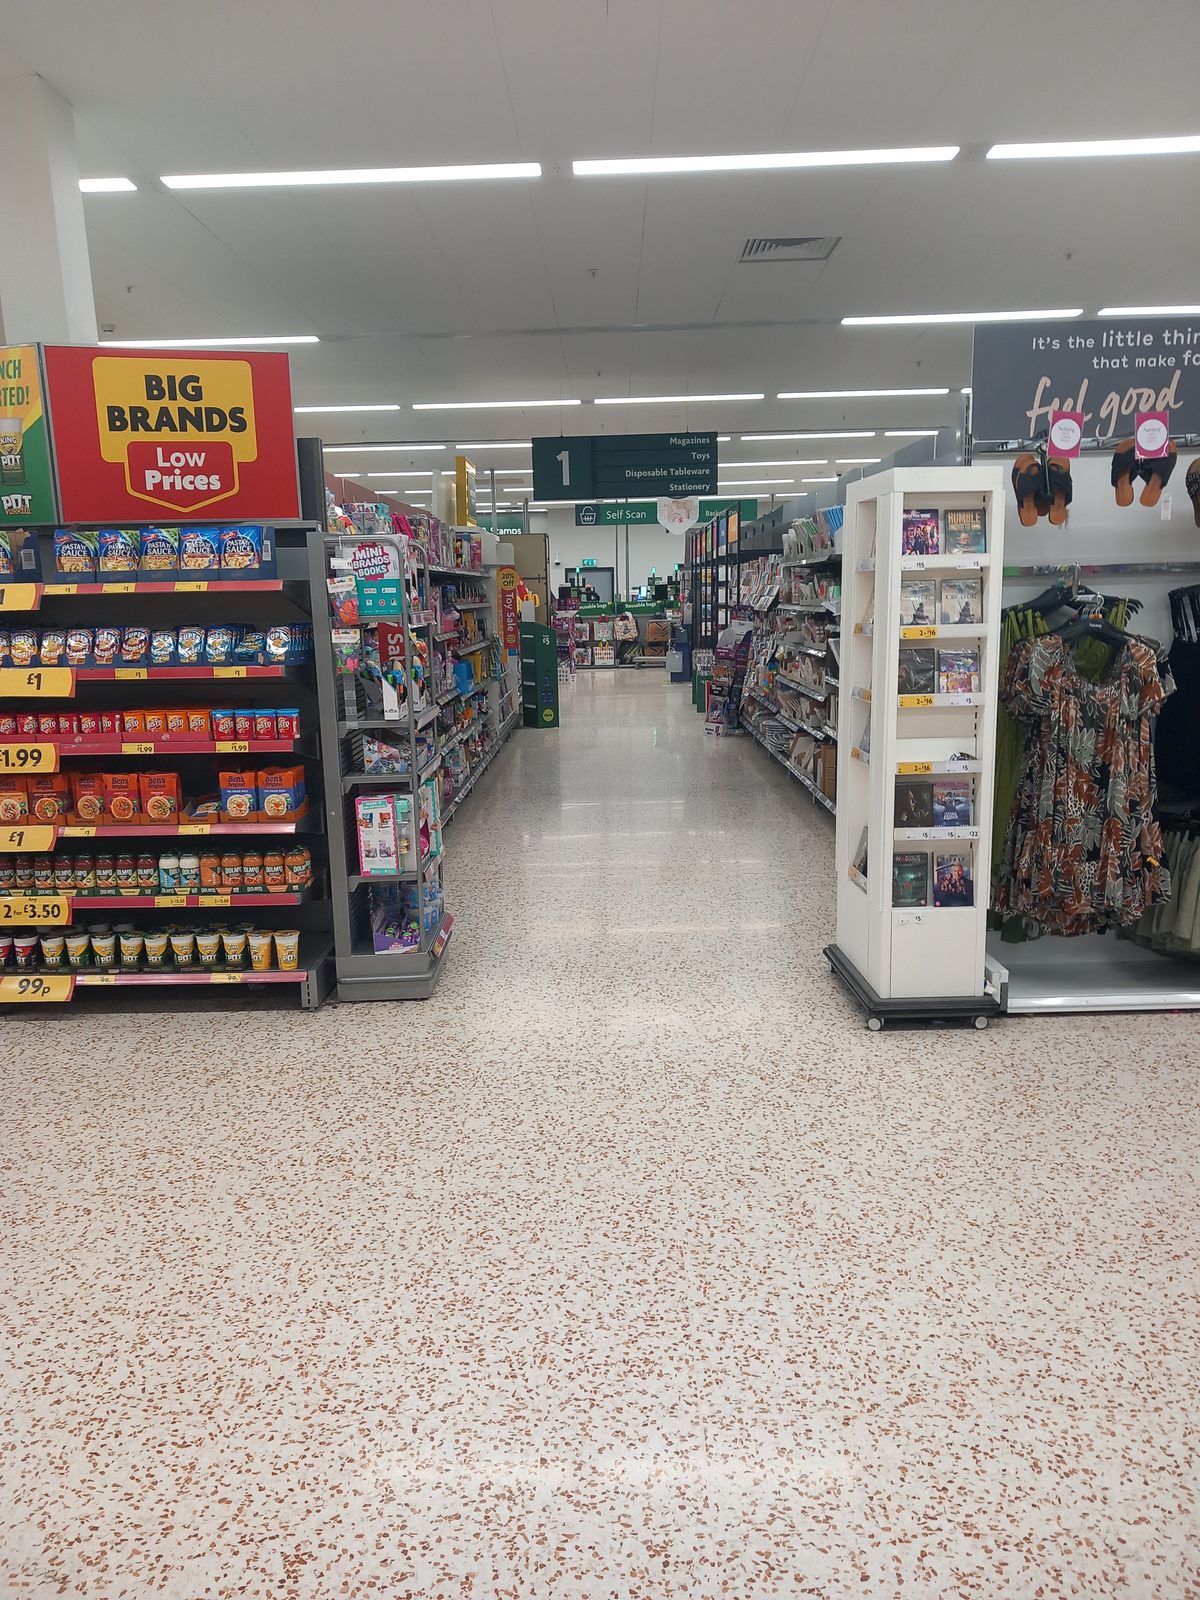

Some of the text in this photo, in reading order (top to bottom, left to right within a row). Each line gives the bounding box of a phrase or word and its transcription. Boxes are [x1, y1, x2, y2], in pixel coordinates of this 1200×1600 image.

[1032, 336, 1061, 350] It's
[1067, 336, 1095, 348] the
[1102, 330, 1154, 347] little
[1092, 355, 1129, 369] that
[1135, 354, 1176, 368] make
[144, 375, 203, 401] BIG
[1096, 369, 1184, 440] good
[106, 405, 248, 433] BRANDS
[669, 436, 710, 447] Magazines
[156, 447, 206, 468] Low
[691, 451, 710, 461] Toys
[556, 450, 570, 486] 1
[625, 467, 710, 480] Disposable Tableware
[145, 469, 222, 491] Prices
[669, 483, 710, 493] Stationery
[1, 493, 33, 508] POT
[606, 510, 647, 520] Self Scan
[948, 511, 981, 525] RUMBLE
[107, 549, 132, 557] SAUCE
[147, 547, 172, 555] SAUCE
[352, 555, 390, 569] BRANDS
[358, 564, 388, 578] BOOKS
[504, 593, 517, 633] Toy Sale
[543, 637, 550, 645] £5
[26, 673, 42, 690] £1
[8, 831, 24, 847] £1
[3, 904, 12, 918] 2
[23, 903, 61, 919] £3.50
[18, 978, 51, 997] 99p
